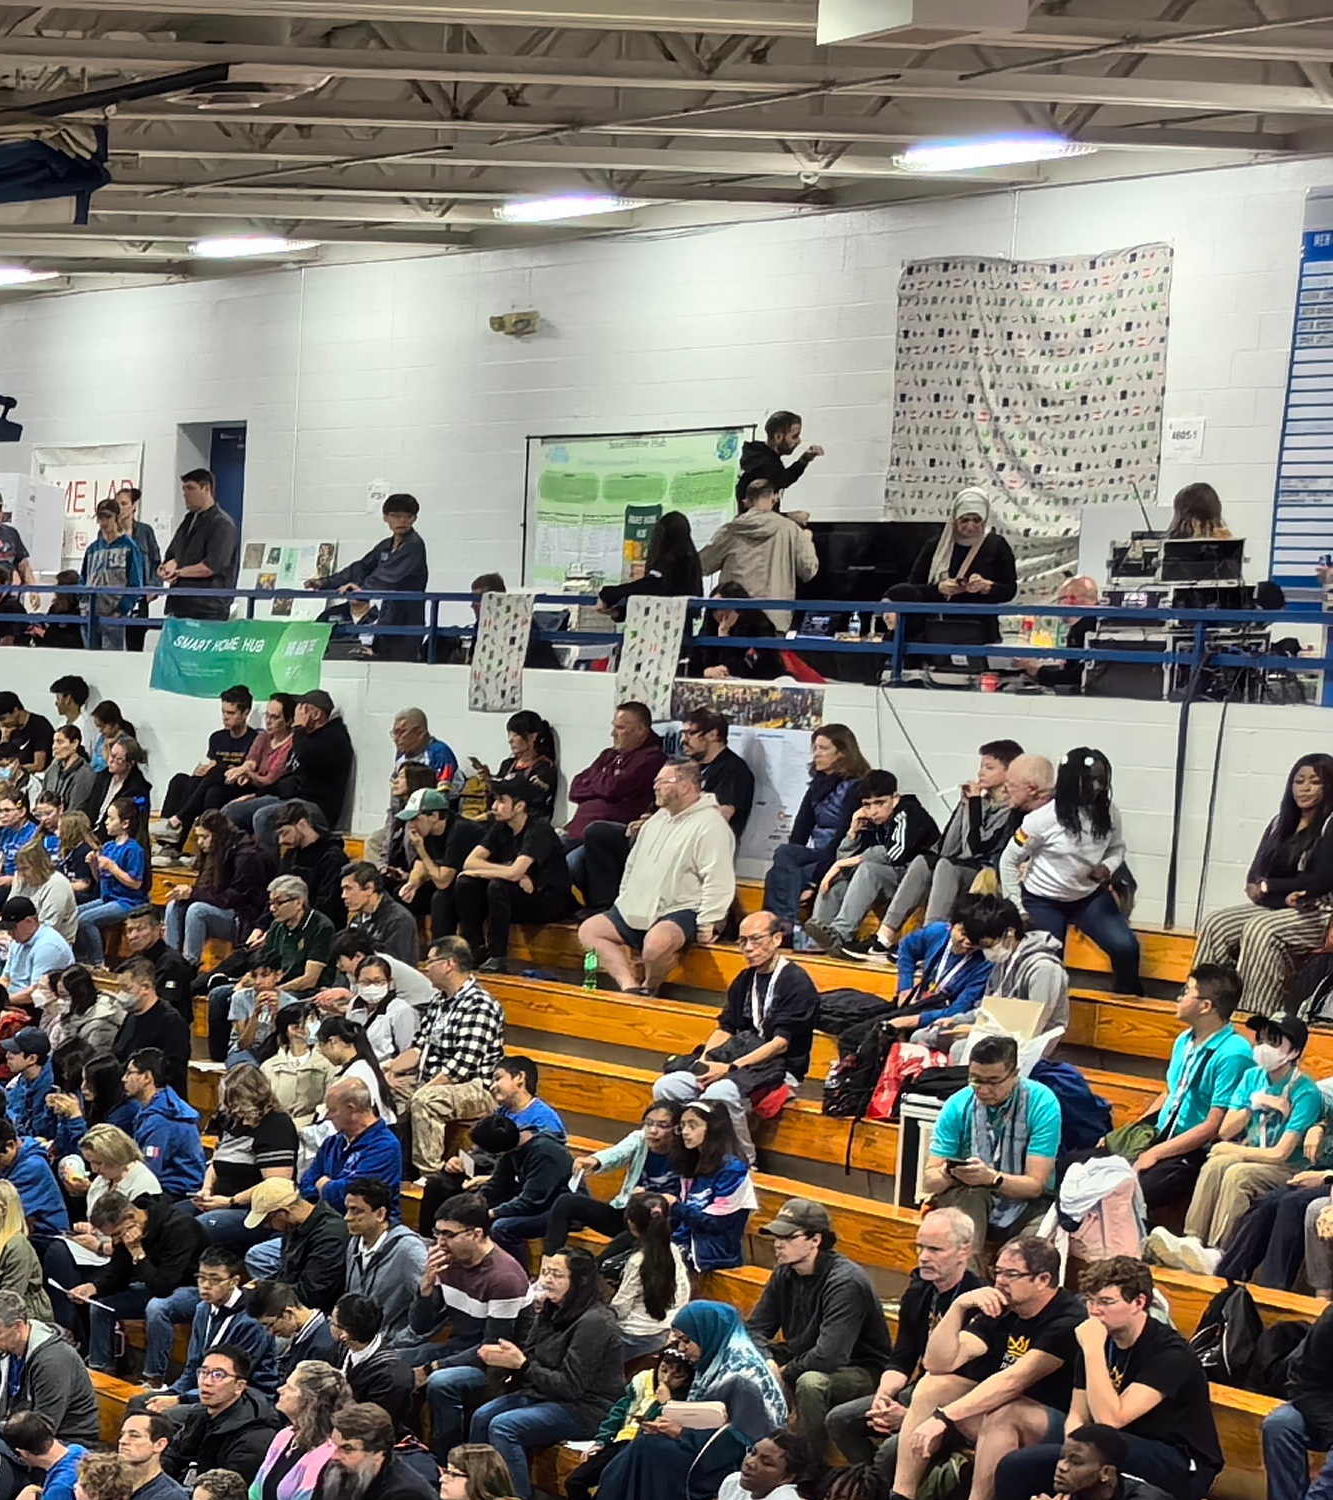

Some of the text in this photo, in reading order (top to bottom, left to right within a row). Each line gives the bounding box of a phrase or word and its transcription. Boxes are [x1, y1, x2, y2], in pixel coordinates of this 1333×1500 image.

[173, 635, 265, 653] SMART HOME HUB
